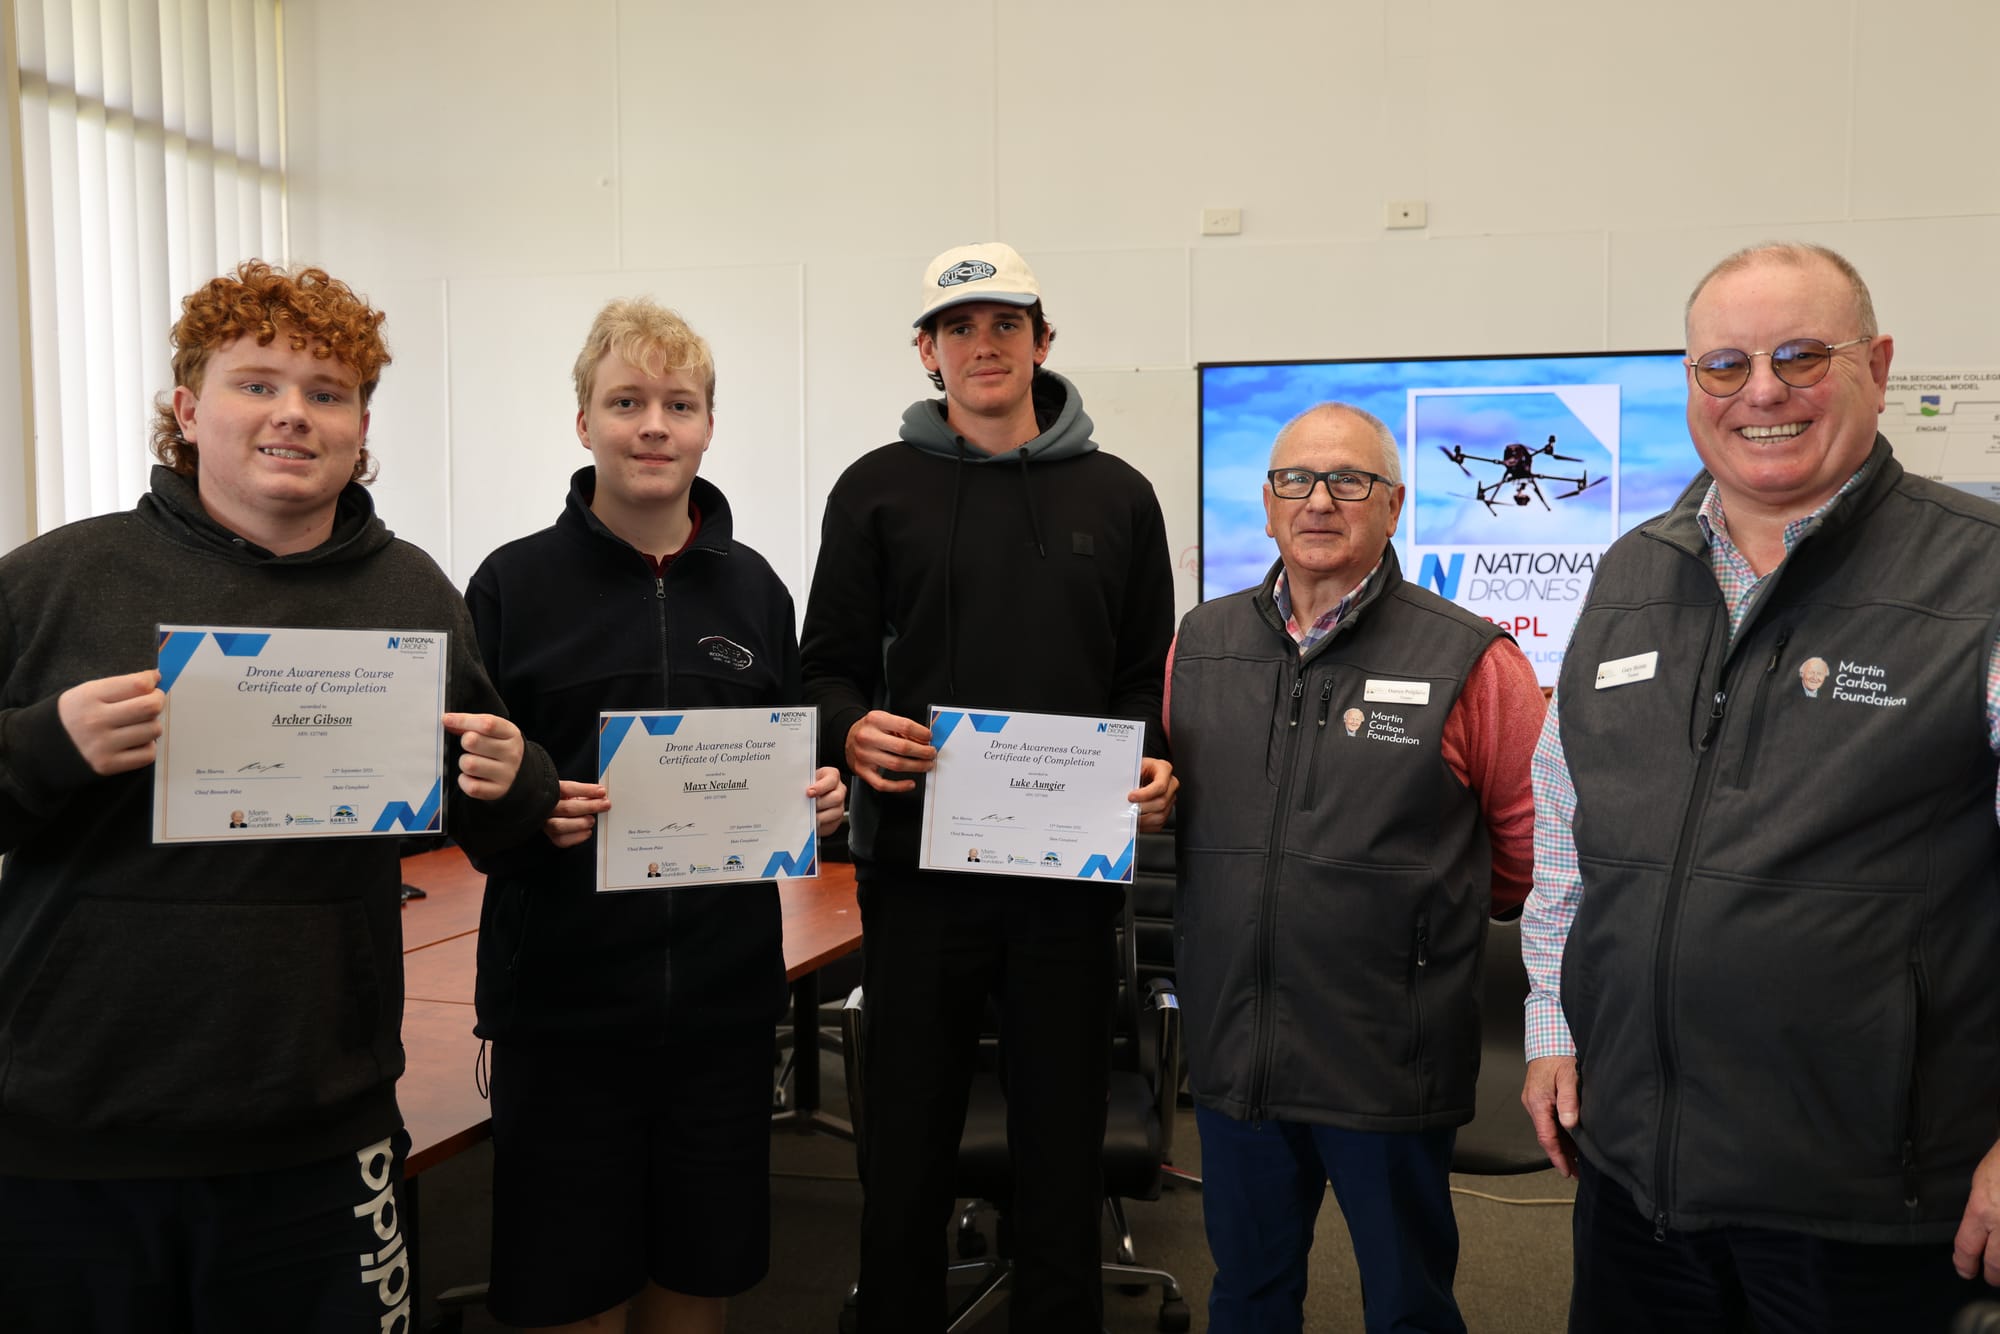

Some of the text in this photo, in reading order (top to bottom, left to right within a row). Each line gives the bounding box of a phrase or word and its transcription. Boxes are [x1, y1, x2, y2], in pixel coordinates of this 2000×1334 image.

[944, 270, 960, 283] RIP
[1886, 383, 1947, 391] NSTRUCTIONAL
[1474, 552, 1603, 574] NATIONA
[1468, 578, 1581, 601] DRONES
[246, 666, 394, 679] Drone Awareness Course
[1838, 660, 1885, 678] Martin
[237, 681, 387, 695] Certificate of Completion
[1835, 673, 1887, 692] Carlson
[1832, 686, 1907, 706] Foundation
[272, 713, 353, 726] Archer Gibson
[1371, 711, 1403, 723] Martin
[1369, 720, 1404, 734] Carlson
[1366, 730, 1420, 745] Foundation
[665, 739, 776, 753] Drone Awareness Course
[990, 739, 1102, 756] Drone Awareness Course
[659, 752, 771, 766] Certificate of Completion
[984, 751, 1095, 767] Certificate of Completion
[683, 779, 747, 792] Maxx Newland
[1010, 777, 1066, 791] Luke Aungier
[354, 1136, 410, 1334] adida
